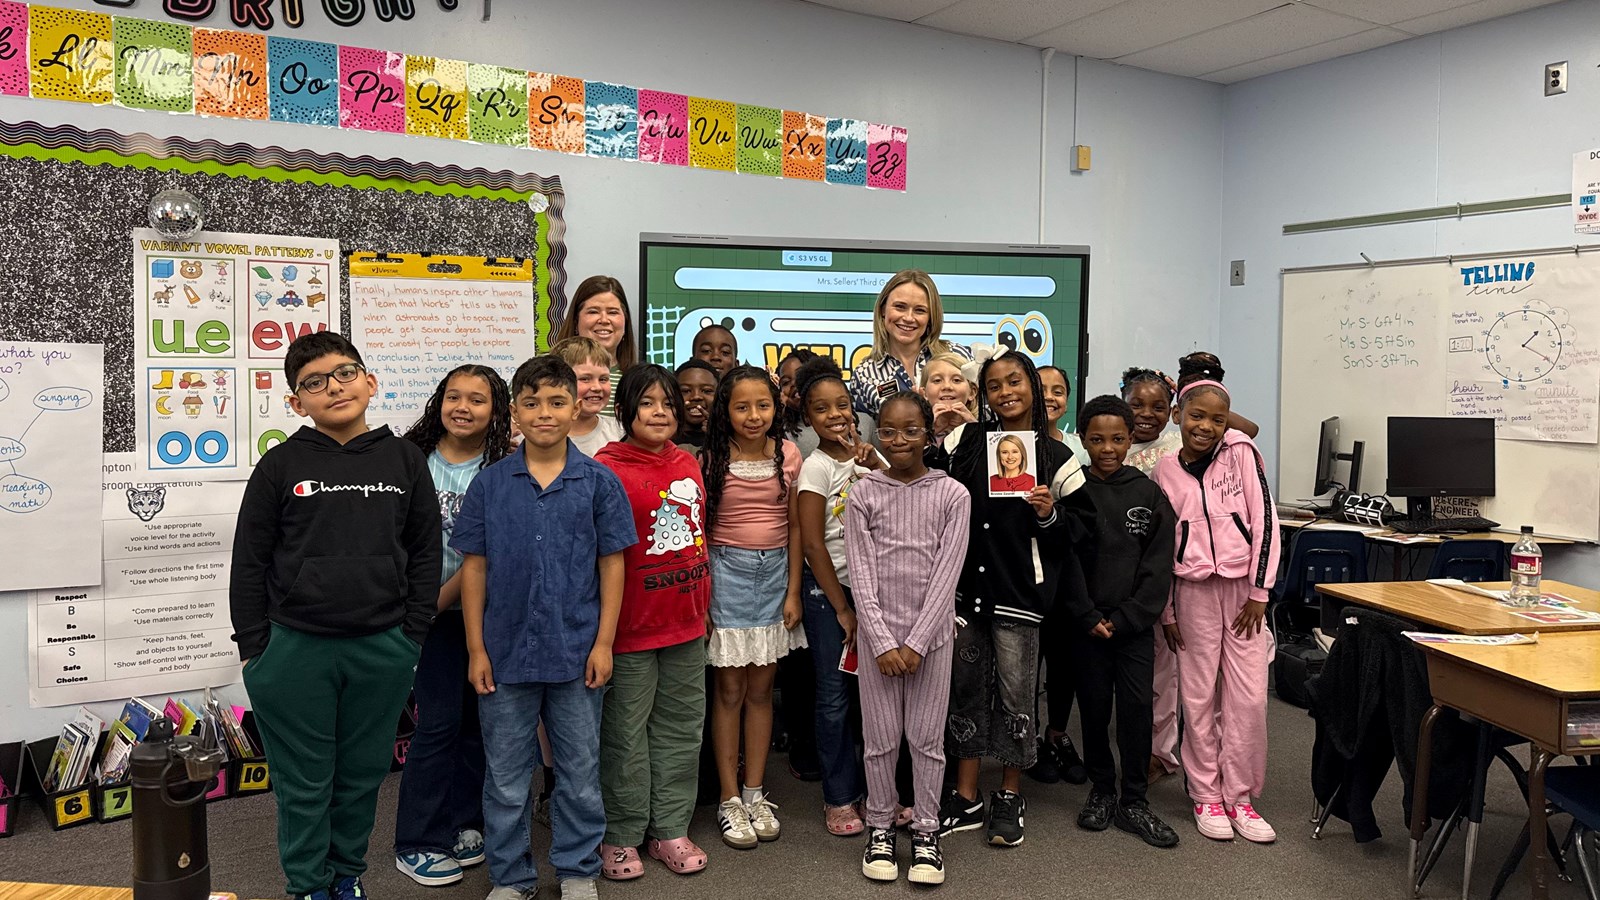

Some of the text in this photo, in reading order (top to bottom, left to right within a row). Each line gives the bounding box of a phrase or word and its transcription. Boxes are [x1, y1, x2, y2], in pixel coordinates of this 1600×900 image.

[39, 34, 98, 72] Ll
[120, 45, 186, 77] Mm
[200, 52, 259, 87] Nn
[280, 62, 329, 94] Oo
[348, 70, 399, 112] Pp
[417, 78, 460, 122] Qq
[477, 87, 520, 118] Rr
[644, 110, 684, 138] Uu
[695, 117, 731, 145] Vv
[742, 126, 778, 149] Ww
[787, 130, 822, 156] Xx
[831, 139, 864, 173] Yy
[870, 143, 902, 178] Zz
[140, 240, 333, 259] VARIANT VOWEL PATTERNS U
[1461, 262, 1535, 285] TELLING
[355, 282, 522, 298] Finally, humans inspire other humans
[1466, 283, 1533, 296] time
[371, 297, 397, 308] Team
[399, 299, 416, 307] that
[460, 300, 480, 309] tells
[500, 300, 518, 309] that
[364, 313, 386, 321] when
[396, 313, 439, 321] astronauts
[446, 316, 457, 325] go
[1340, 318, 1355, 329] Mr
[365, 326, 394, 336] people
[401, 325, 414, 337] get
[486, 325, 503, 333] This
[389, 339, 420, 349] curiosity
[425, 337, 438, 346] for
[441, 340, 469, 350] people
[472, 338, 480, 346] to
[483, 339, 510, 349] explore
[1340, 336, 1355, 348] Ms
[0, 346, 71, 366] what you
[364, 352, 514, 362] In conclusion, I believe that humans
[384, 365, 397, 374] the
[425, 365, 448, 373] choice
[408, 379, 430, 387] show
[1450, 380, 1483, 394] hour
[1535, 381, 1578, 397] minute
[38, 395, 86, 407] singing
[381, 402, 391, 410] the
[396, 402, 419, 410] stars
[157, 430, 228, 464] oo
[1211, 472, 1235, 490] baby
[2, 482, 47, 495] reading
[293, 480, 405, 497] Champion
[1221, 478, 1242, 503] phat
[9, 499, 44, 508] math
[163, 522, 202, 531] appropriate
[171, 574, 198, 582] listening
[644, 562, 709, 591] SNOOPY
[68, 606, 75, 615] B
[158, 604, 188, 613] prepared
[152, 615, 183, 623] materials
[185, 612, 214, 620] correctly
[47, 634, 96, 643] Responsible
[69, 647, 76, 656] S
[151, 646, 175, 654] objects
[186, 642, 212, 650] yourself
[139, 656, 176, 665] self-control
[210, 650, 233, 658] actions
[56, 676, 88, 684] Choices
[244, 767, 266, 784] 10
[64, 797, 84, 816] 6
[112, 791, 128, 810] 7
